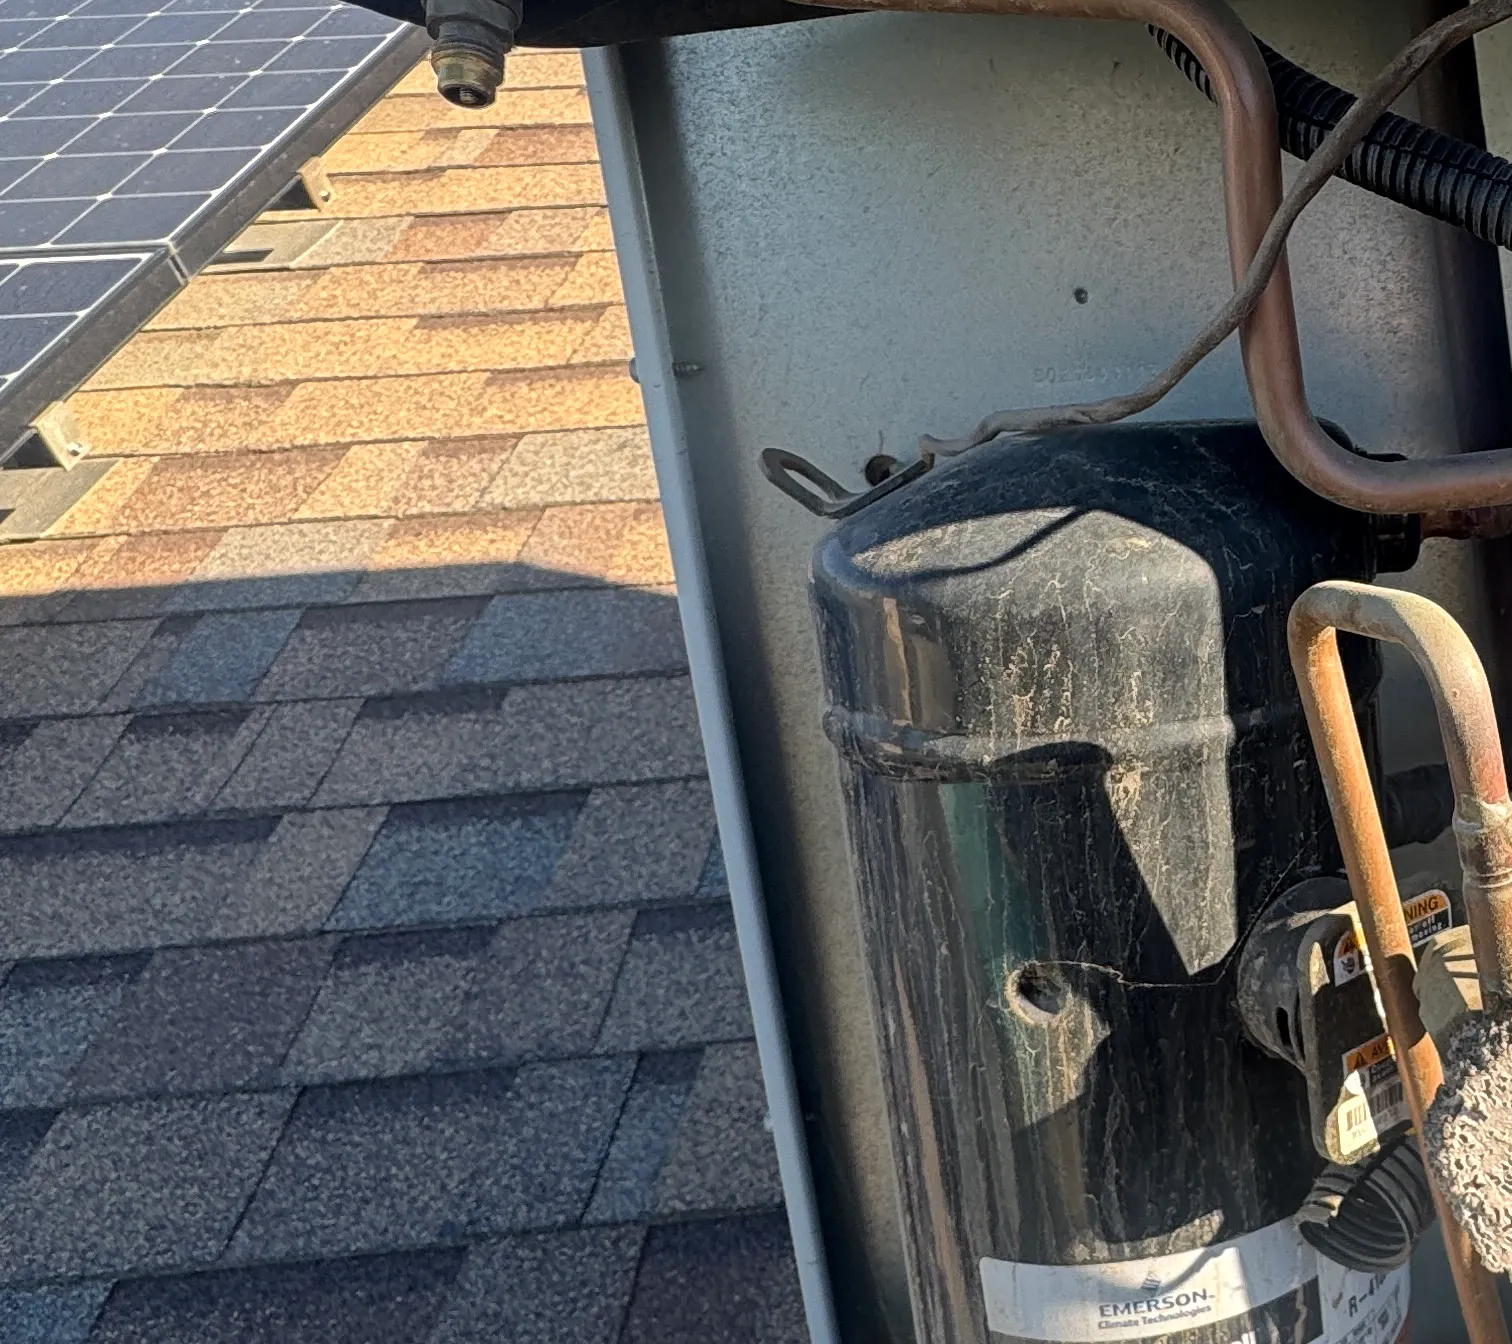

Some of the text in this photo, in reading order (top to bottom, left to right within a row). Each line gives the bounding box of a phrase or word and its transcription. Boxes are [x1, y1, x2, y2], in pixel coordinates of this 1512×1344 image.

[1098, 1288, 1207, 1317] EMERSON
[1098, 1305, 1212, 1330] Climate Technologies
